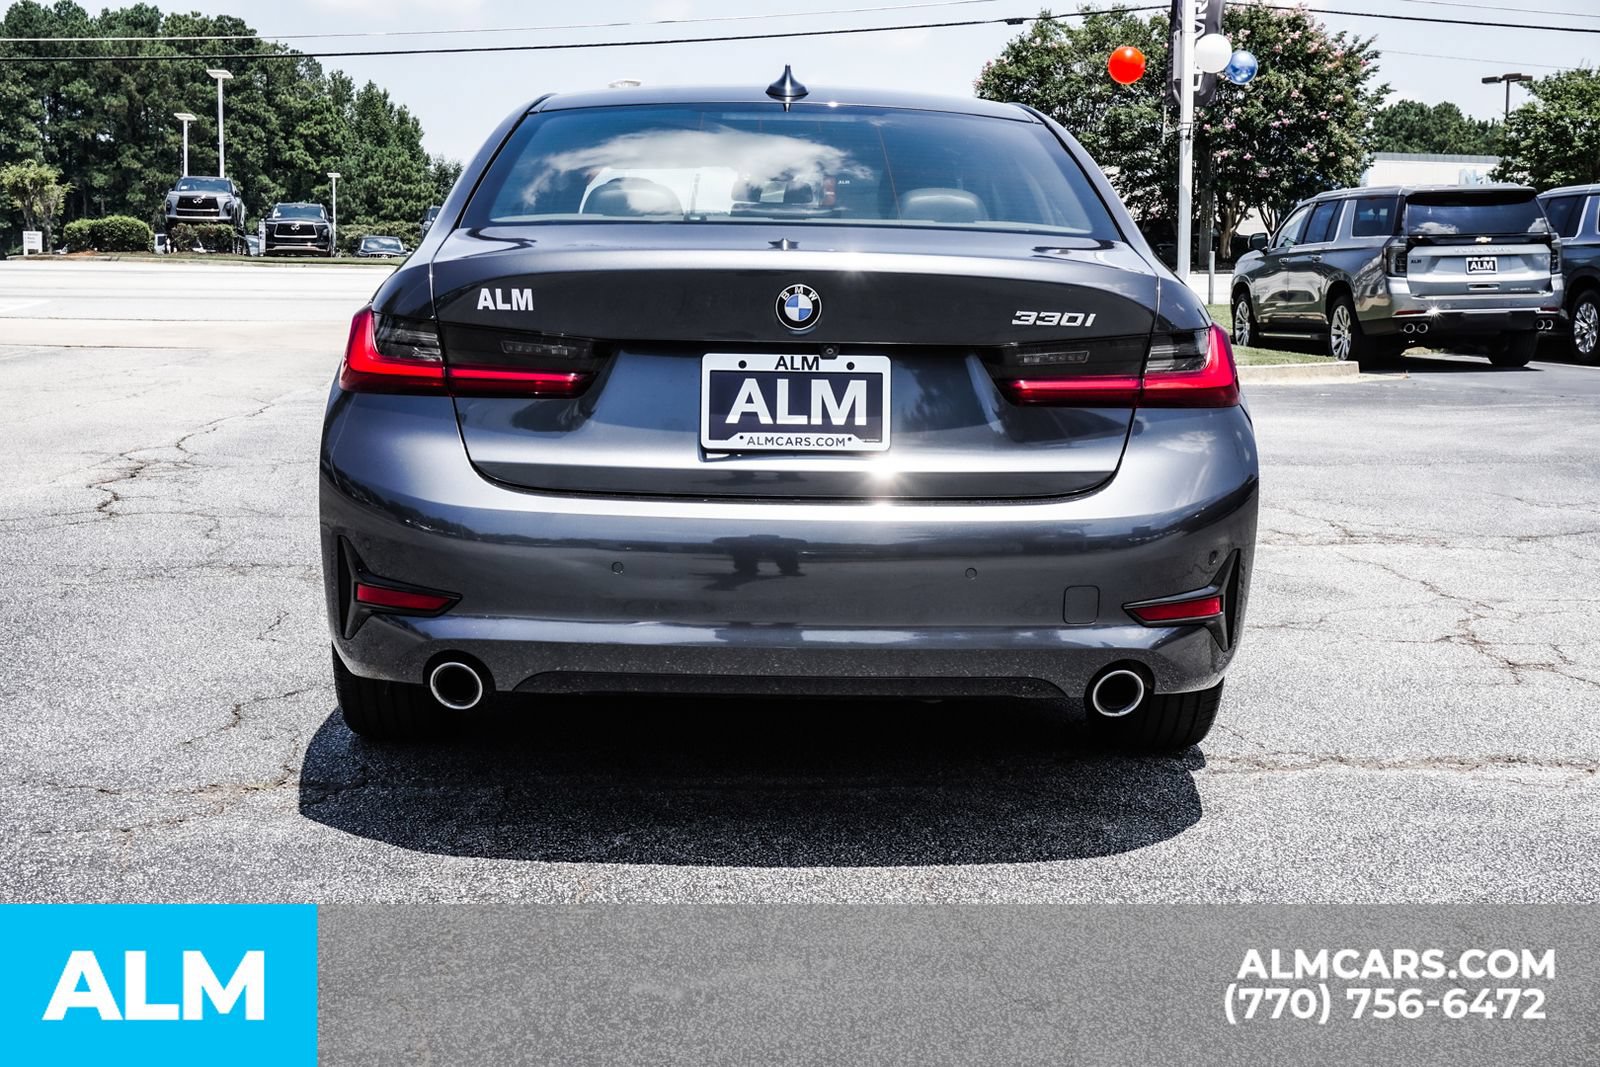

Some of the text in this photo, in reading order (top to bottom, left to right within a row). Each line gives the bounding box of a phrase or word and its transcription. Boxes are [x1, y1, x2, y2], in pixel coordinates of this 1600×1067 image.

[1470, 261, 1494, 270] ALM
[477, 288, 534, 311] ALM
[780, 286, 818, 301] BMW
[774, 355, 820, 371] ALM
[725, 378, 867, 426] ALM
[746, 436, 846, 447] ALMCARS.COM
